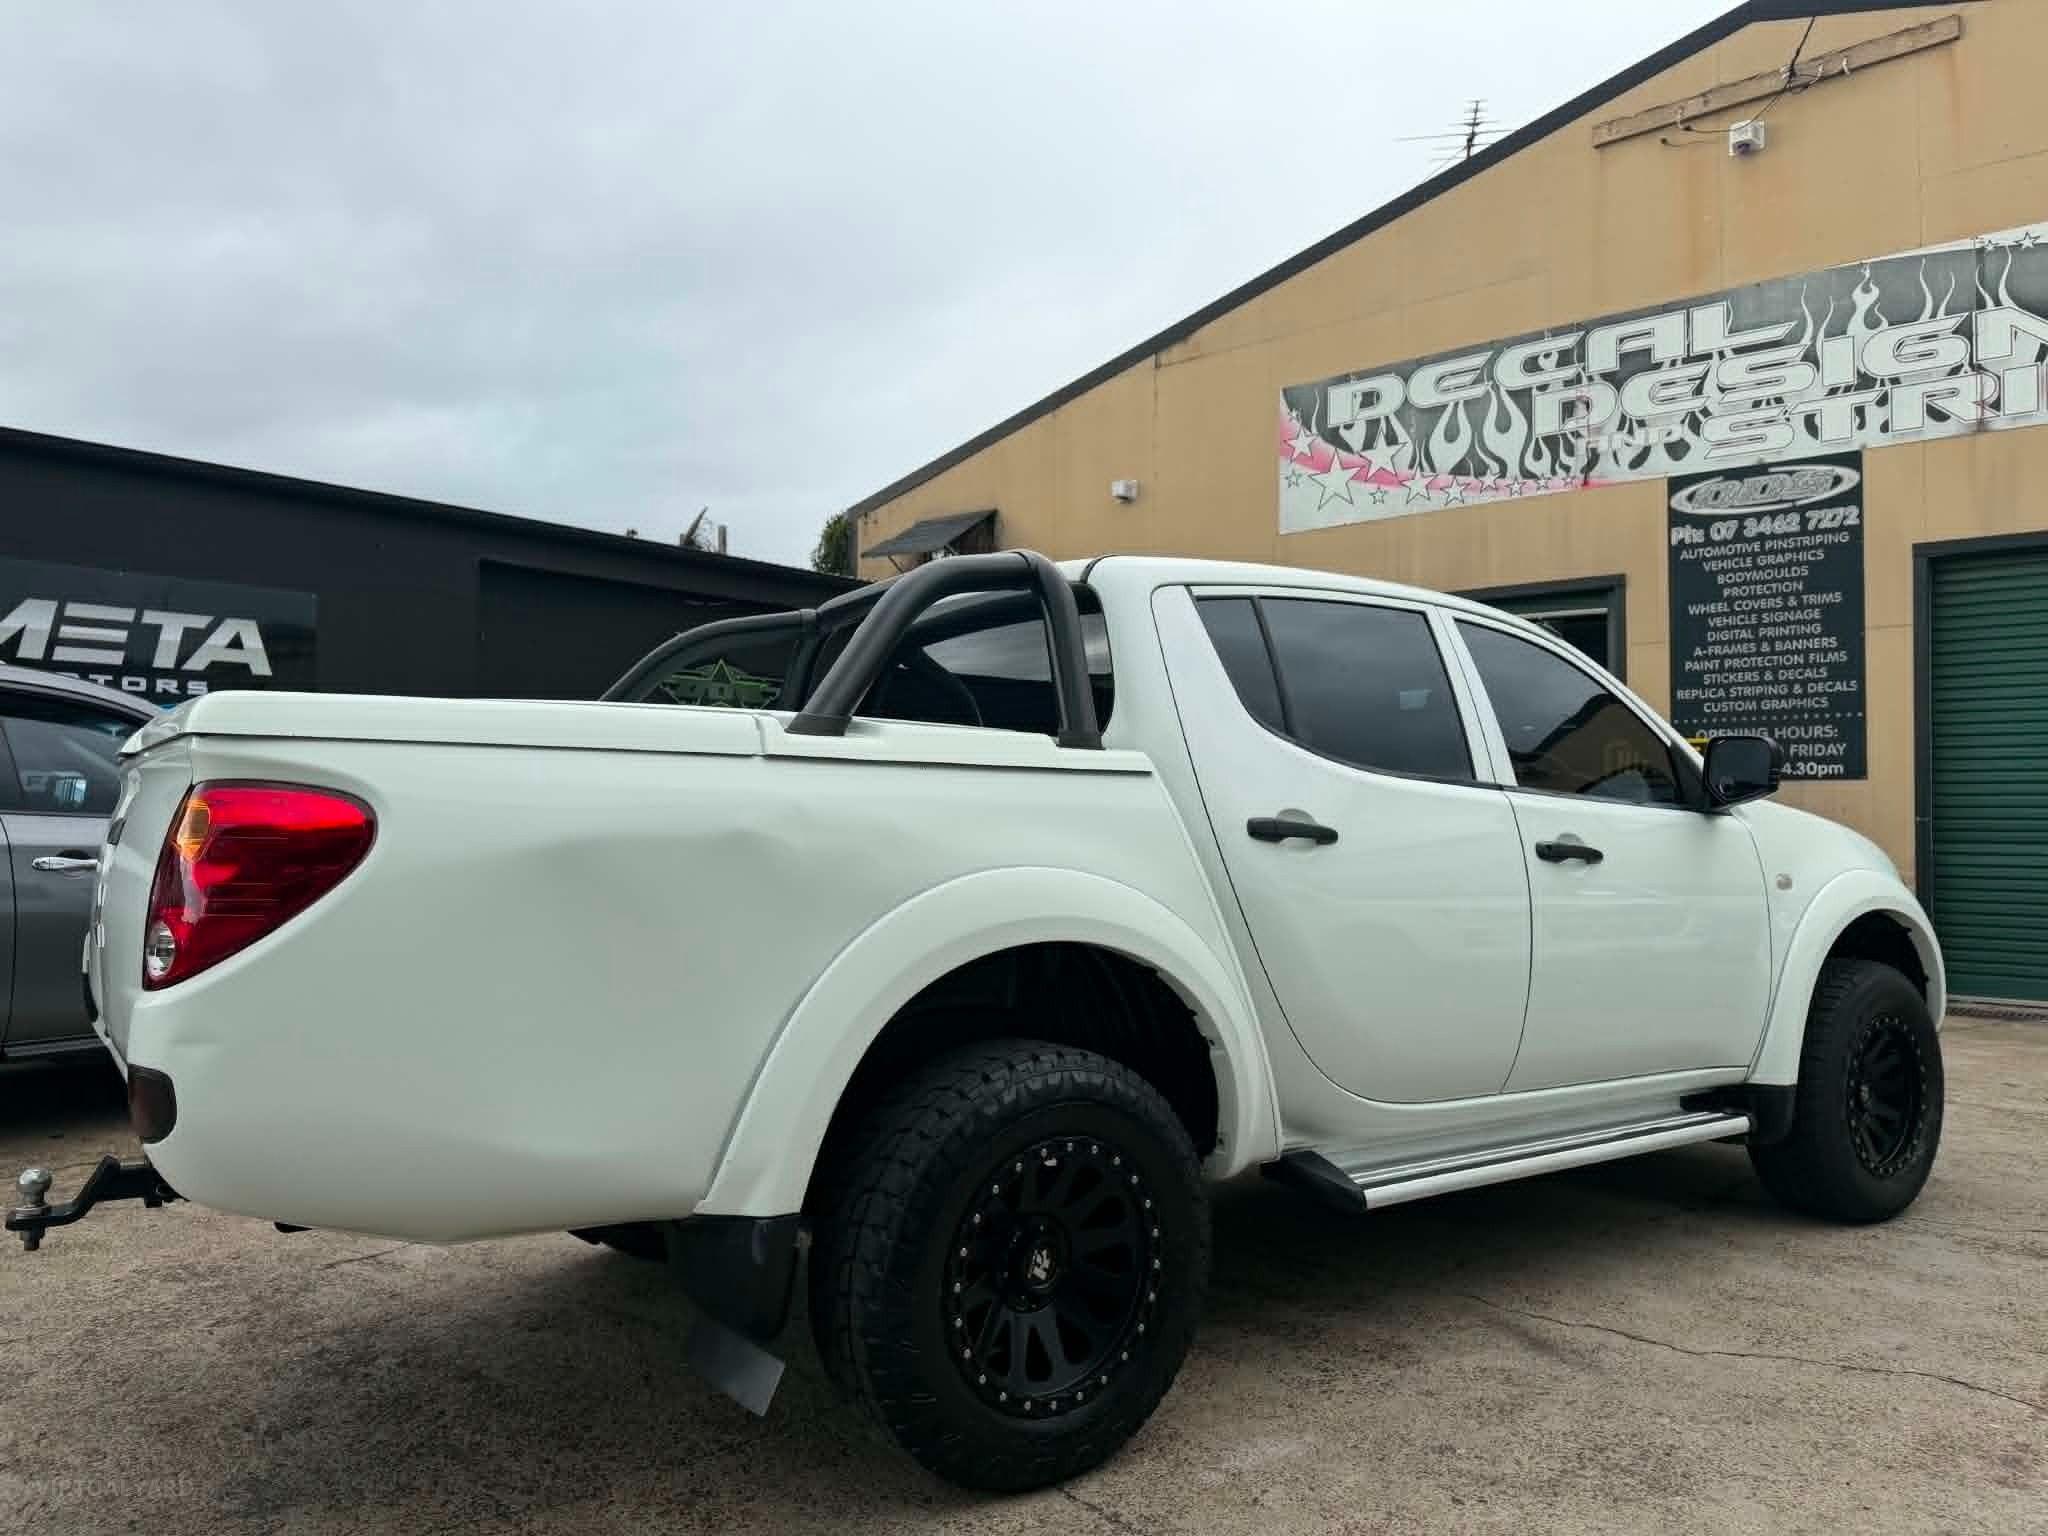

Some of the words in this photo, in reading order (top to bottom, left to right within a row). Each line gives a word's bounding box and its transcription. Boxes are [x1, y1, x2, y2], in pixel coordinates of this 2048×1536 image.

[1328, 302, 1798, 427] DECAL
[1701, 361, 2048, 460] STRI
[1710, 519, 1740, 543] 07
[1743, 512, 1801, 539] 3462
[1680, 541, 1761, 560] AUTOMOTIVE
[1764, 532, 1850, 552] PINSTRIPING
[1703, 557, 1753, 572] VEHICLE
[1756, 549, 1825, 567] GRAPHICS
[1717, 565, 1809, 585] BODYMOULDS
[1723, 581, 1804, 599] PROTECTION
[1688, 600, 1730, 616] WHEEL
[1735, 597, 1783, 612] COVERS
[1787, 596, 1798, 607] &
[1802, 592, 1842, 606] TRIMS
[1708, 613, 1759, 628] VEHICLE
[1761, 608, 1822, 624] SIGNAGE
[1707, 626, 1754, 642] DIGITAL
[1758, 623, 1822, 638] PRINTING
[1693, 642, 1757, 658] A-FRAMES
[1760, 641, 1771, 653] &
[1775, 636, 1838, 652] BANNERS
[1685, 658, 1720, 673] PAINT
[1724, 653, 1804, 670] PROTECTION
[1808, 650, 1848, 664] FILMS
[54, 671, 208, 696] TORS
[1703, 670, 1760, 685] STICKERS
[1763, 669, 1774, 681] &
[1778, 666, 1828, 681] DECALS
[1677, 686, 1726, 700] REPLICA
[1729, 682, 1788, 698] STRIPING
[1792, 682, 1804, 695] &
[1807, 679, 1858, 693] DECALS
[1703, 699, 1757, 713] CUSTOM
[1760, 696, 1830, 712] GRAPHICS
[1774, 724, 1839, 739] HOURS:
[1789, 743, 1847, 757] FRIDAY
[1781, 761, 1844, 778] 4.30pm
